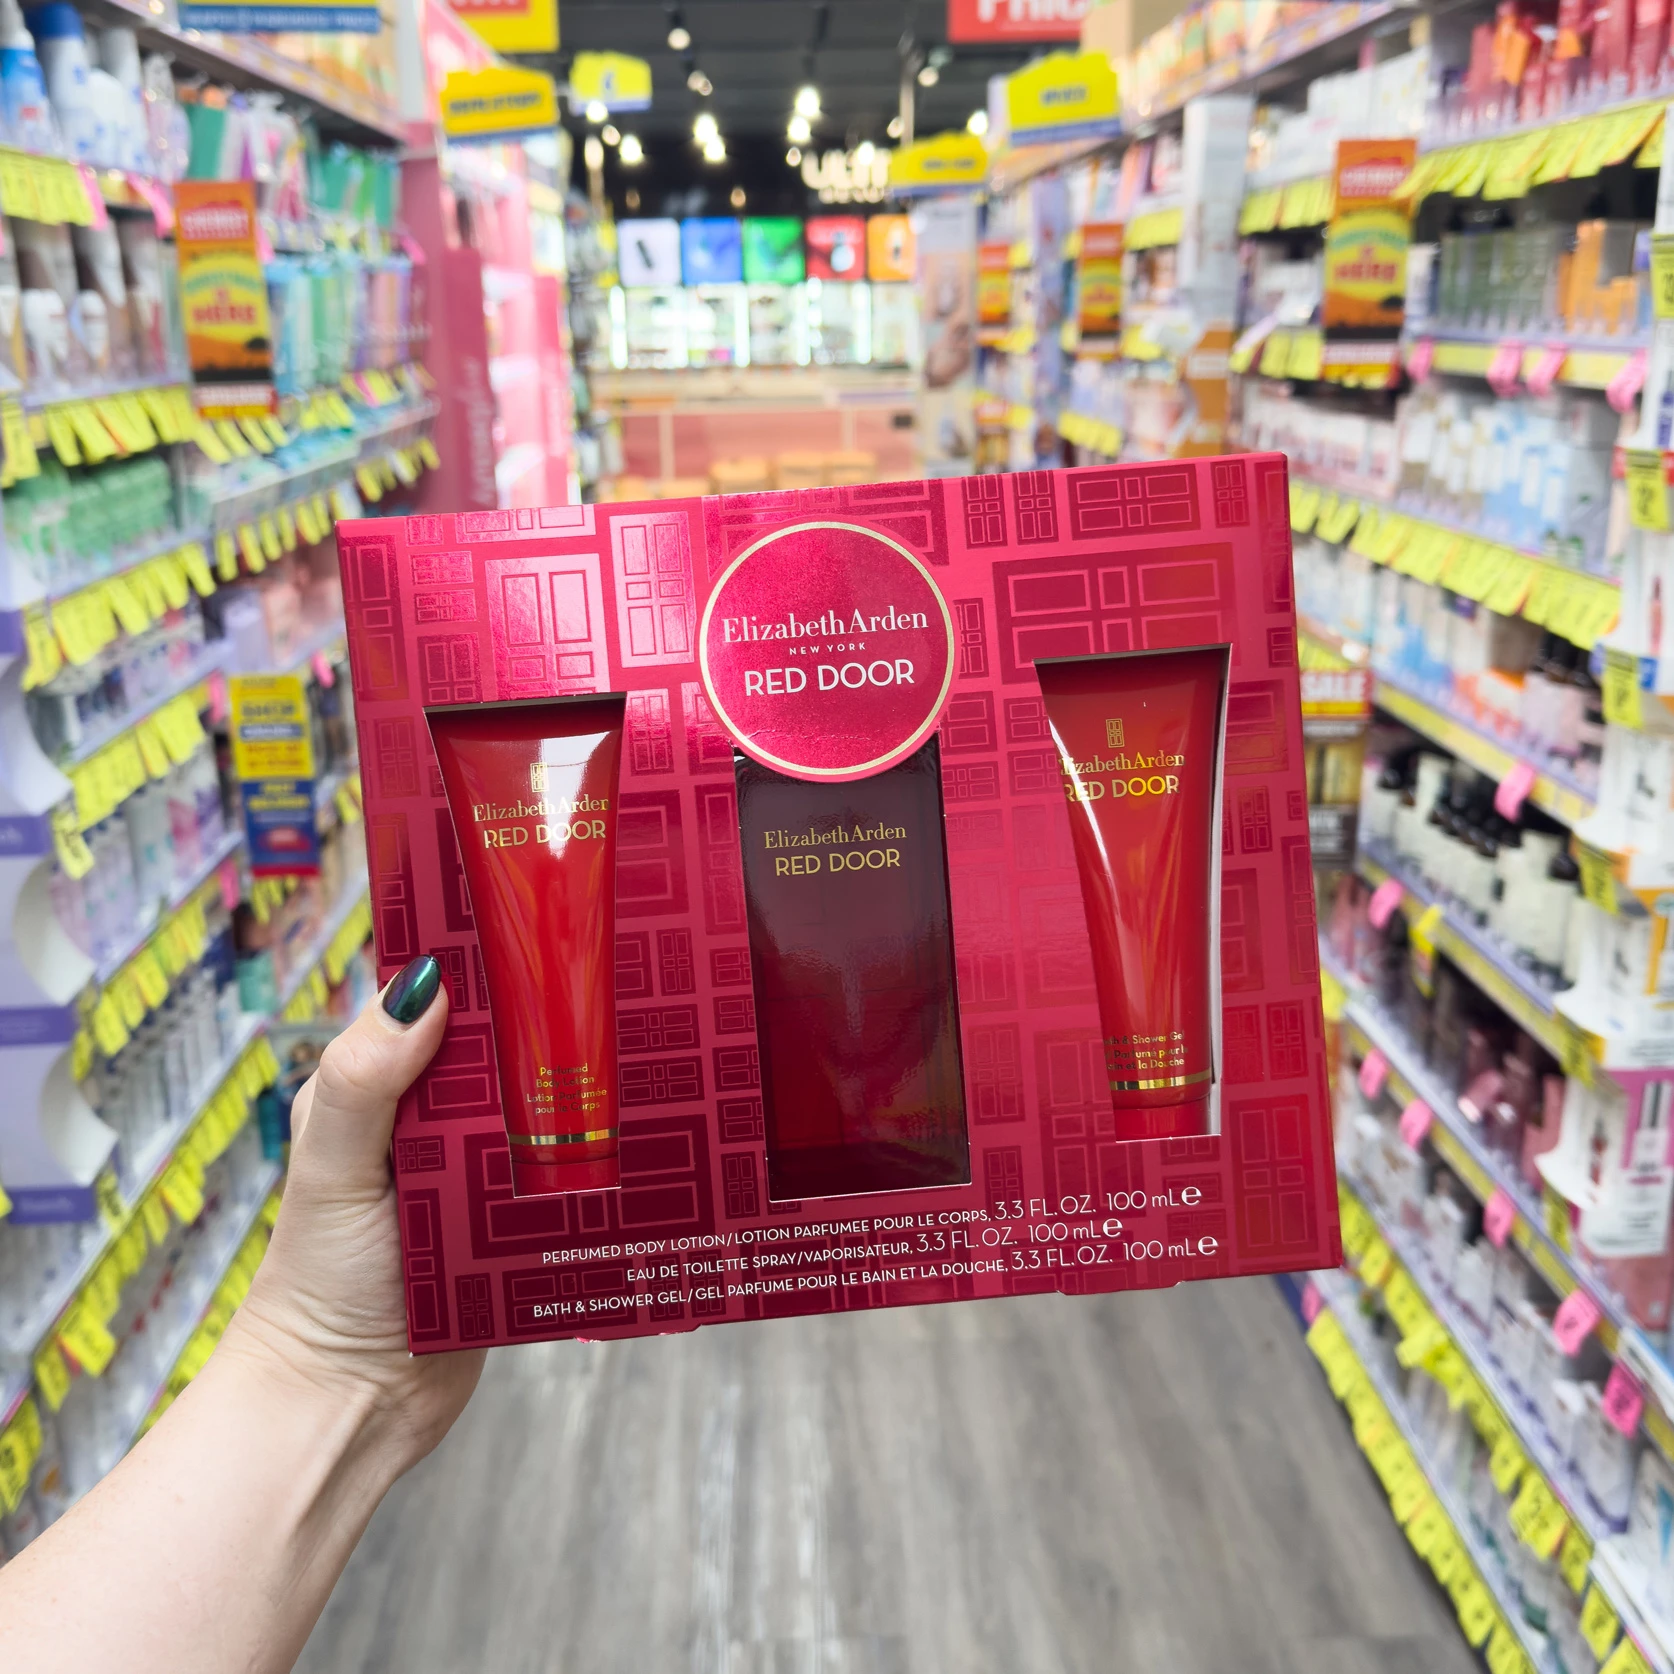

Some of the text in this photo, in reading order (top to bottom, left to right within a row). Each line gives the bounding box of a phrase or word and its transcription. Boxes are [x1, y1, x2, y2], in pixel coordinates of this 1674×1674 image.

[721, 605, 929, 643] Elizabeth Arden
[789, 642, 866, 655] NEW YORK
[744, 659, 915, 696] RED DOOR
[1134, 750, 1185, 769] Arden
[1111, 775, 1180, 798] DOOR
[473, 798, 556, 822] Elizabeth
[483, 819, 606, 849] RED DOOR
[763, 822, 907, 849] Elizabeth Arden
[775, 848, 901, 876] RED DOOR
[542, 1245, 621, 1264] PERFUMED
[625, 1240, 667, 1256] BODY
[794, 1219, 870, 1238] PARFUMEE
[873, 1217, 914, 1231] POUR
[918, 1213, 934, 1226] LE
[938, 1209, 992, 1225] CORPS,
[994, 1200, 1025, 1220] 3.3
[1106, 1190, 1147, 1211] 100
[627, 1267, 656, 1281] EAU
[660, 1263, 679, 1278] DE
[682, 1257, 749, 1275] TOILETTE
[916, 1232, 946, 1252] 3.3
[1028, 1222, 1068, 1242] 100
[533, 1302, 571, 1317] BATH
[575, 1300, 586, 1313] &
[589, 1292, 654, 1311] SHOWER
[727, 1278, 794, 1297] PARFUME
[798, 1275, 838, 1290] POUR
[841, 1271, 858, 1285] LE
[862, 1269, 896, 1284] BAIN
[900, 1266, 917, 1280] ET
[920, 1264, 938, 1278] LA
[941, 1259, 1009, 1276] DOUCHE,
[1012, 1250, 1041, 1270] 3.3
[1123, 1240, 1164, 1260] 100
